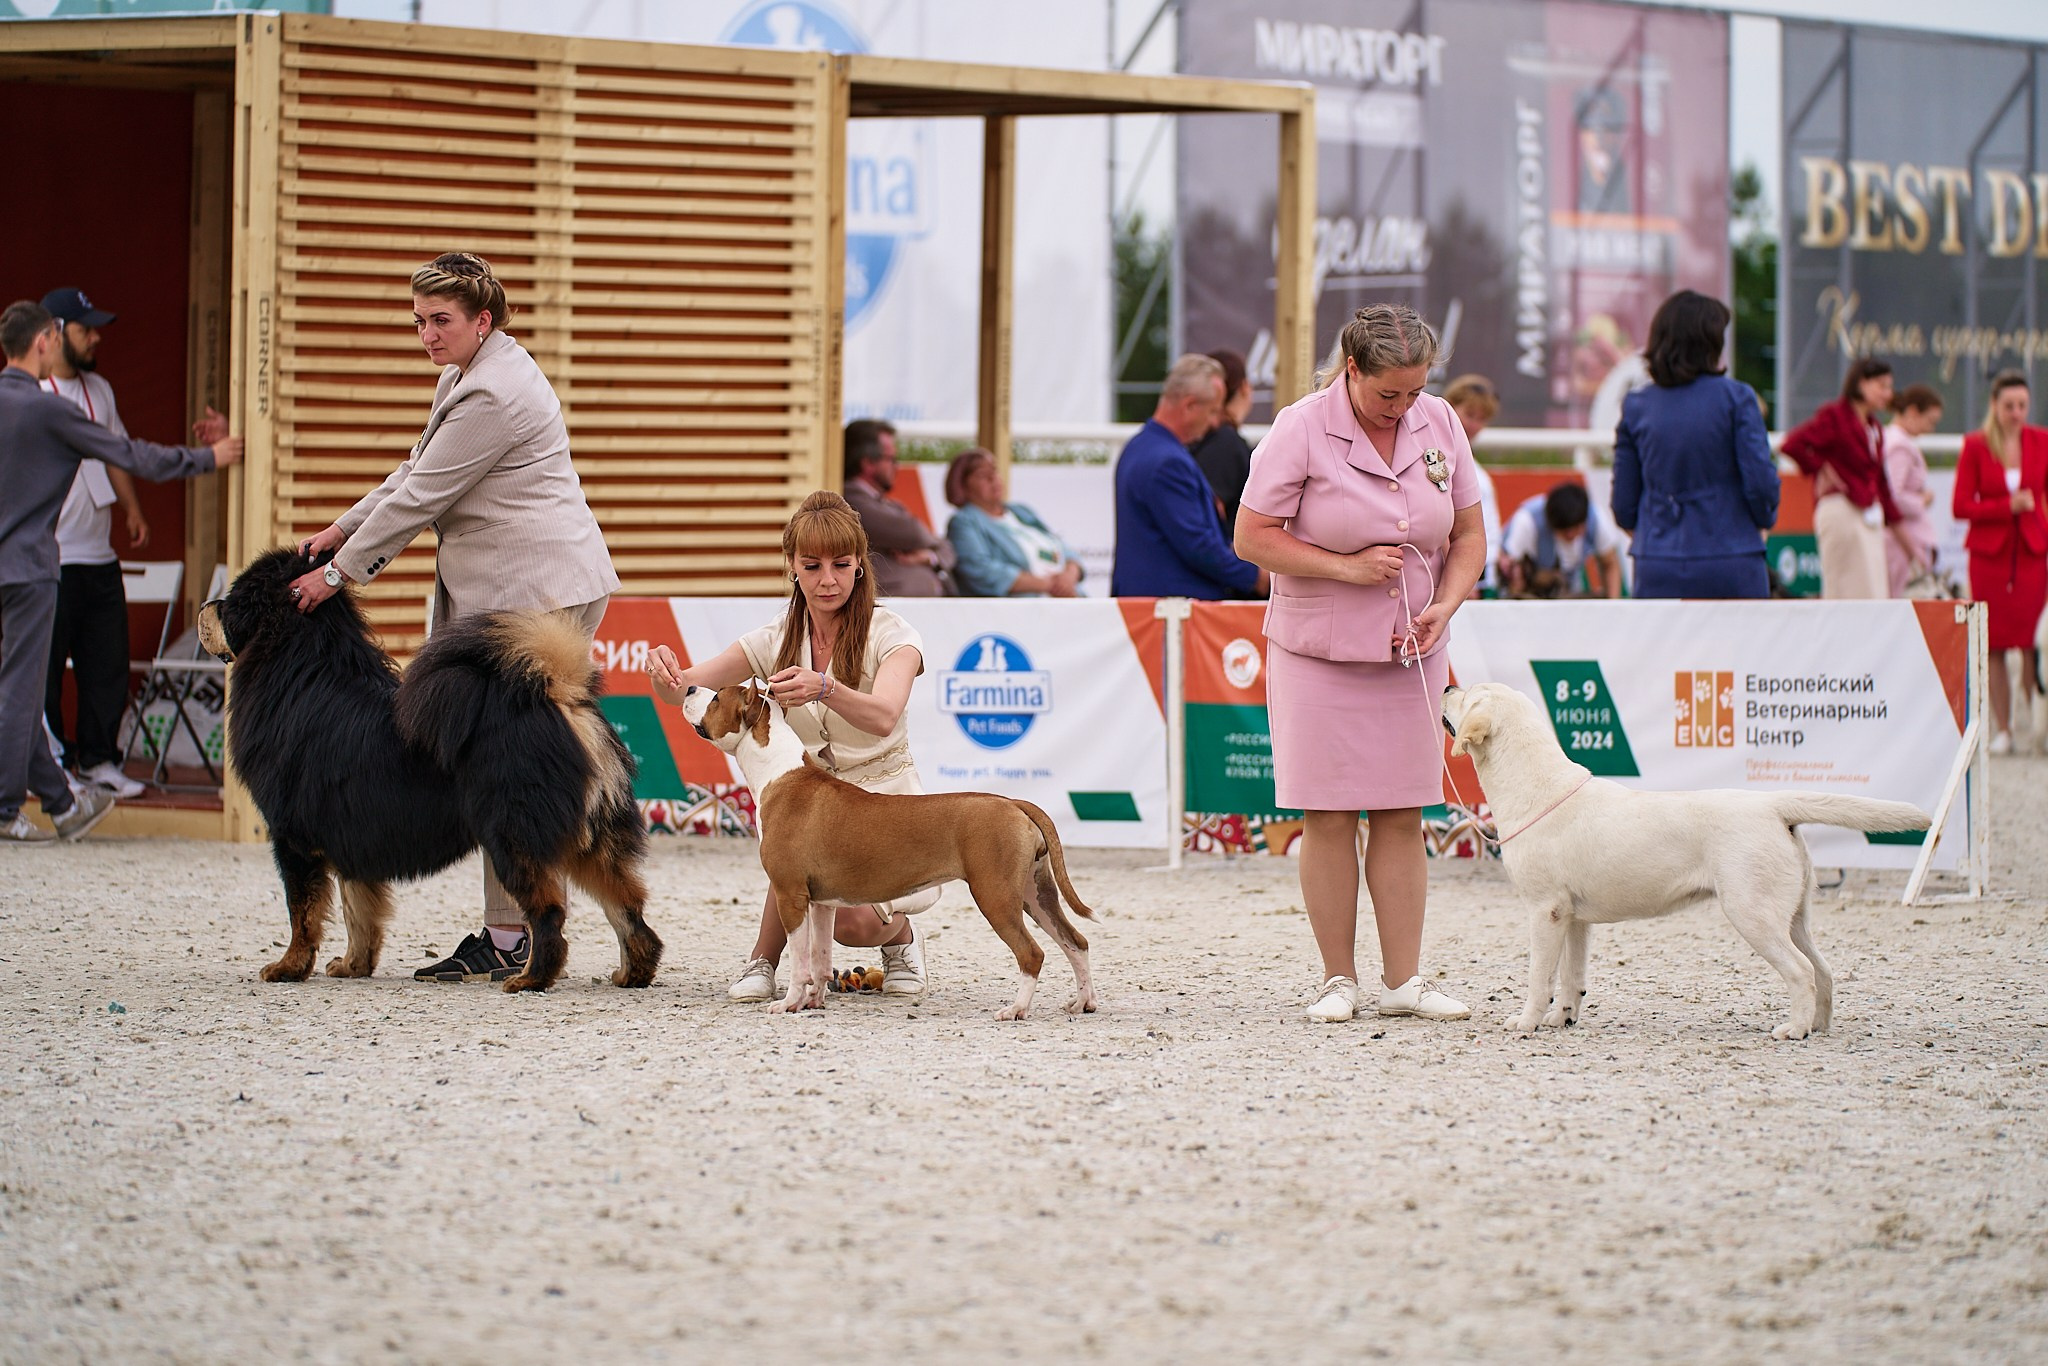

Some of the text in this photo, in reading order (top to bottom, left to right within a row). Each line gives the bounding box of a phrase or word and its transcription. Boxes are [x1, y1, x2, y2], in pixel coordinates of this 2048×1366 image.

[1254, 16, 1447, 87] МИРАТОРГ
[848, 153, 916, 217] na
[1800, 155, 1972, 256] BEST
[1514, 96, 1548, 379] МИРАТОРГ
[258, 297, 270, 418] CORNER
[590, 639, 650, 673] СИЯ
[945, 676, 1043, 707] Farmina
[1745, 673, 1875, 696] Европейский
[1555, 707, 1611, 725] ИЮНЯ
[1745, 699, 1888, 721] Ветеринарный
[967, 717, 1024, 736] Pet Foods
[1570, 729, 1614, 750] 2024
[1677, 724, 1732, 745] EVC
[1745, 725, 1804, 748] Центр
